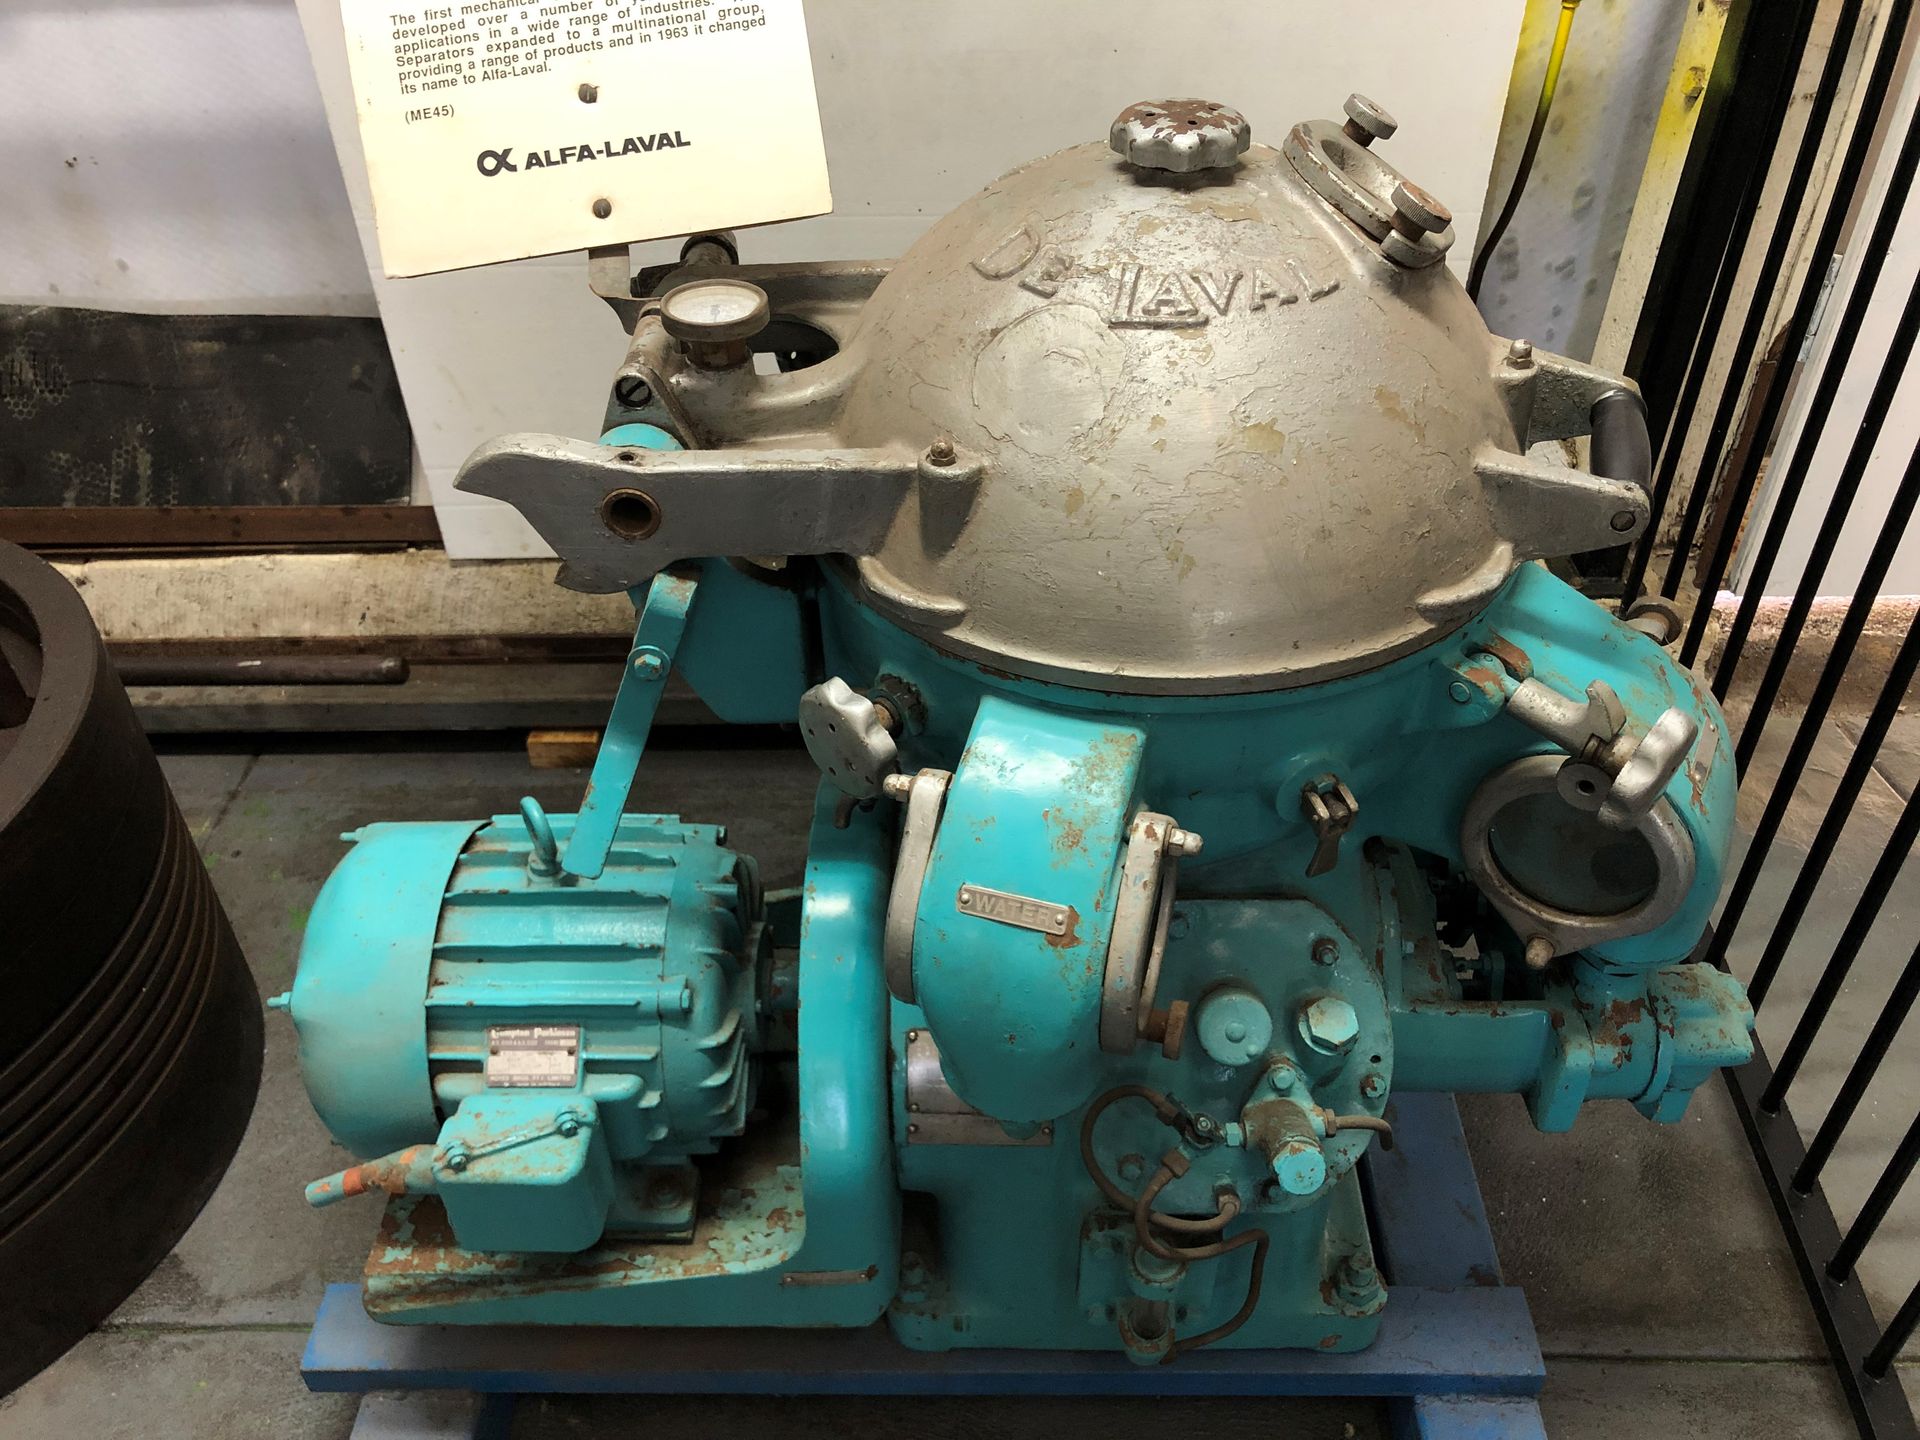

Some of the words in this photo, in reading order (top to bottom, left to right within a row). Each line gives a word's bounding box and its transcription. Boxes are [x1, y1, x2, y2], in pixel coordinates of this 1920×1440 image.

[389, 14, 416, 26] The
[423, 6, 453, 21] first
[460, 0, 540, 16] mechanica
[392, 18, 466, 41] developed
[477, 13, 508, 27] over
[520, 10, 528, 20] a
[539, 0, 593, 17] number
[394, 32, 480, 56] applications
[488, 27, 502, 39] in
[510, 26, 519, 36] a
[527, 18, 560, 33] wide
[568, 12, 608, 27] range
[617, 6, 631, 19] of
[639, 0, 715, 16] industries.
[395, 46, 475, 68] Separators
[486, 31, 555, 54] expanded
[566, 30, 581, 41] to
[592, 27, 601, 37] a
[611, 9, 706, 34] multinational
[717, 4, 764, 21] group,
[398, 62, 463, 87] providing
[467, 60, 476, 70] a
[481, 54, 520, 68] range
[524, 48, 538, 61] of
[543, 40, 604, 61] products
[608, 33, 634, 49] and
[639, 33, 652, 44] in
[657, 26, 689, 41] 1963
[694, 24, 704, 36] it
[708, 14, 766, 34] changed
[400, 83, 417, 95] its
[421, 77, 458, 92] name
[462, 74, 476, 85] to
[481, 60, 552, 82] Alfa-Laval.
[404, 104, 456, 125] (ME45)
[524, 130, 693, 171] ALFA-LAVAL
[1106, 255, 1343, 332] LAVAL
[974, 892, 1053, 928] WATER
